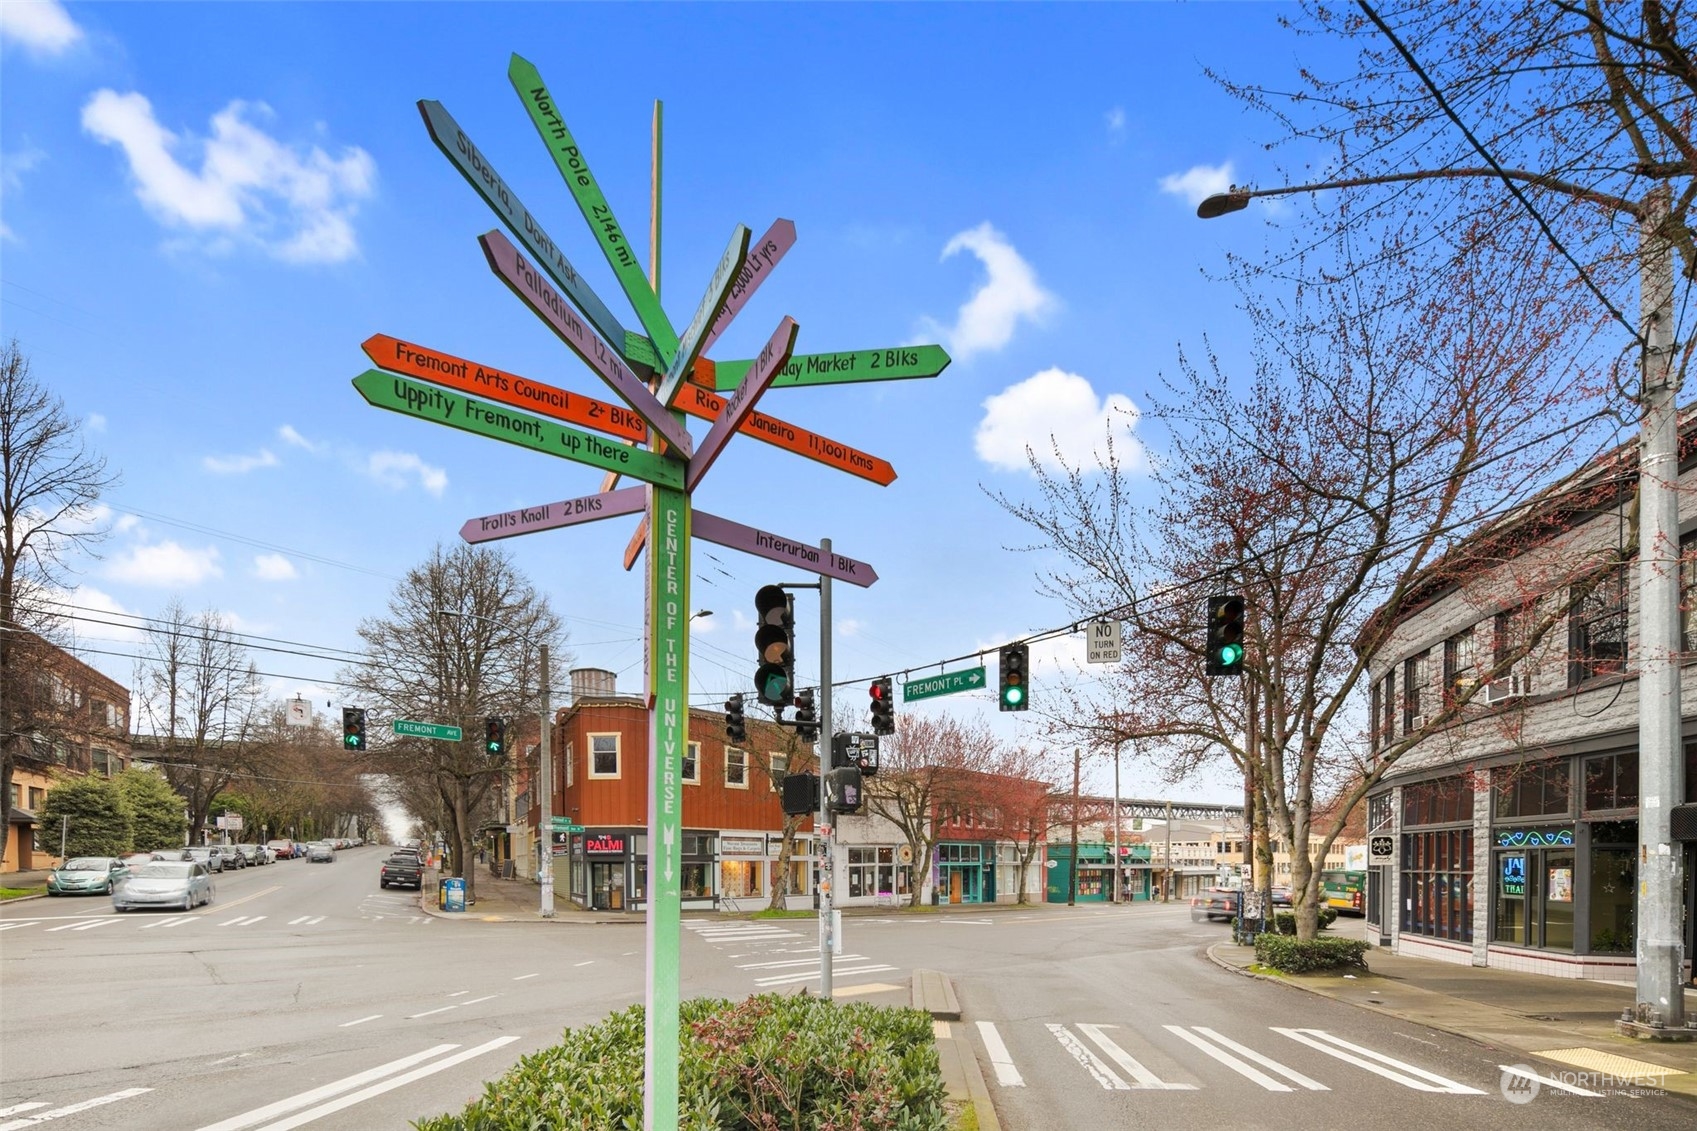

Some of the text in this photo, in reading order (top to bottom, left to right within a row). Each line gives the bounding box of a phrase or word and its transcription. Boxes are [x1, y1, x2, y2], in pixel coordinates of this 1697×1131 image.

[530, 87, 637, 268] North Pole 2,146 mi
[759, 240, 778, 266] yrs
[516, 252, 583, 341] Palladium
[609, 357, 624, 381] mi
[806, 355, 857, 375] Market
[870, 353, 881, 369] 2
[884, 350, 919, 368] Blks
[395, 342, 644, 432] Fremont Arts Council 2+ Blks
[394, 379, 630, 464] Uppity Fremont, up there
[695, 389, 721, 412] Rio
[749, 411, 796, 442] Janeiro
[849, 449, 875, 472] kms
[479, 497, 603, 532] Troll's Knoll 2 Blks
[755, 530, 820, 563] Interurban
[838, 556, 857, 576] Blk
[1095, 625, 1112, 637] NO
[1090, 650, 1119, 659] ON RED
[1094, 640, 1114, 649] TURN
[663, 509, 679, 815] CENTER OF THE UNIVERSE
[906, 676, 964, 697] FREMONT PL
[398, 723, 436, 735] FREMONT
[587, 840, 624, 850] PALMI
[1505, 884, 1525, 894] THAI
